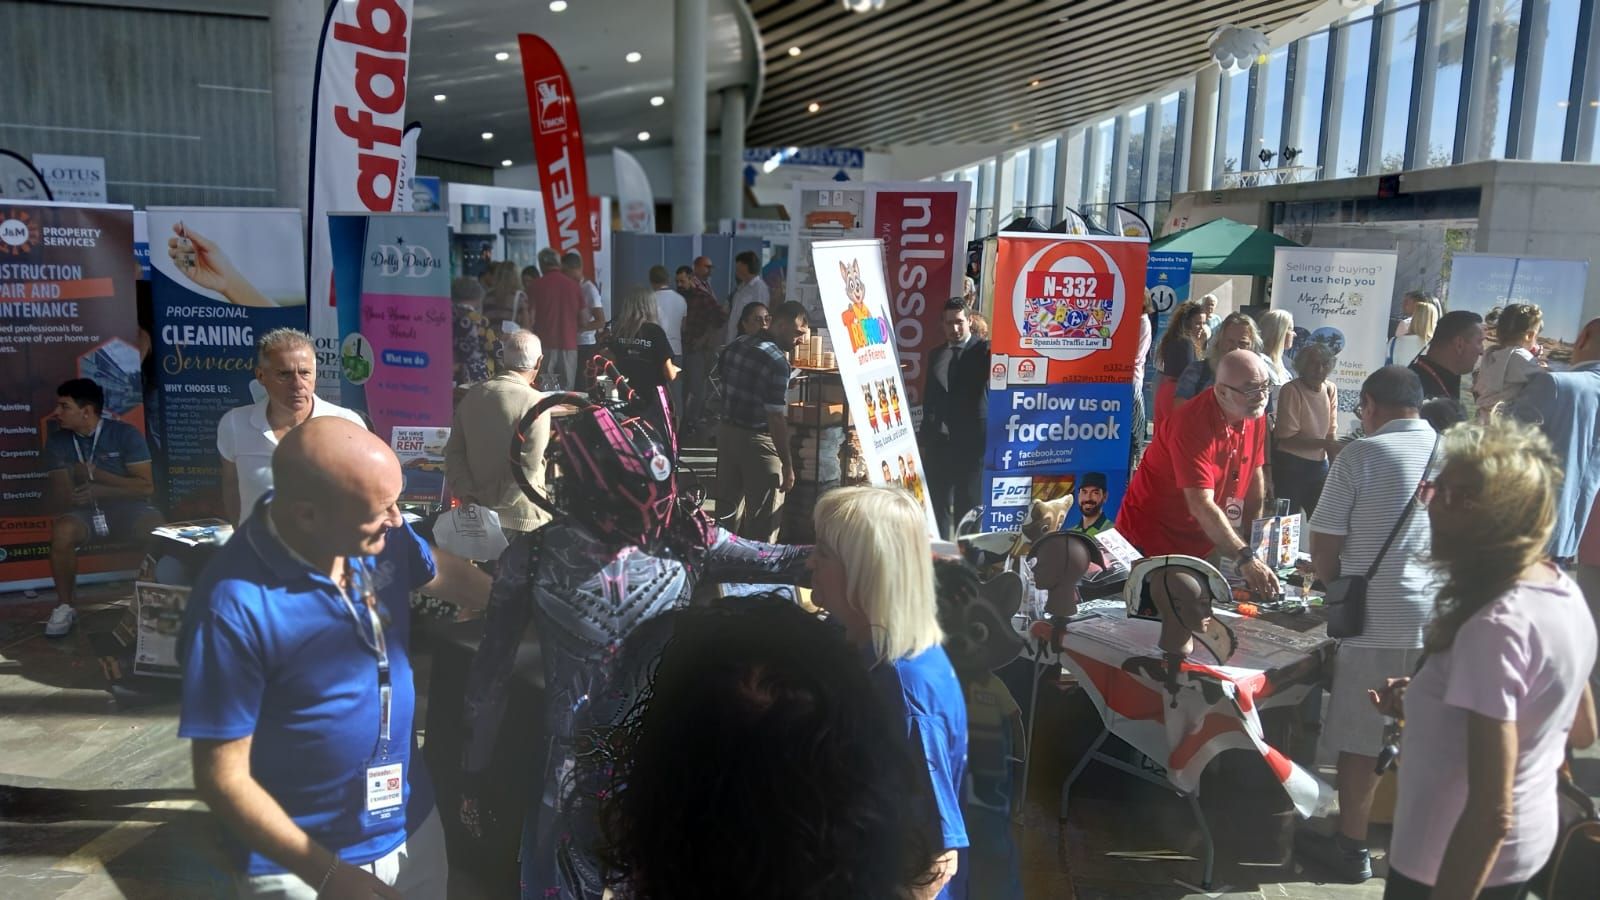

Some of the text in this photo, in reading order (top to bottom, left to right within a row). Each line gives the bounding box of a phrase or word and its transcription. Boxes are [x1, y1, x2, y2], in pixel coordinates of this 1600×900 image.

[43, 226, 101, 238] PROPERTY
[43, 236, 96, 247] SERVICES
[1286, 262, 1383, 276] Selling or buying?
[1290, 274, 1376, 287] Let us help you
[31, 283, 60, 298] AND
[1043, 276, 1098, 298] N-332
[896, 197, 946, 406] nilsson
[166, 306, 249, 318] PROFESIONAL
[1310, 302, 1358, 318] Properties
[14, 324, 70, 335] professionals
[71, 324, 83, 333] for
[161, 324, 254, 346] CLEANING
[33, 333, 42, 343] of
[44, 336, 63, 345] your
[64, 334, 88, 343] home
[1033, 339, 1099, 347] Spanish Traffic Law
[162, 342, 255, 376] Services
[385, 353, 425, 365] What we do
[1339, 361, 1363, 369] Make
[1335, 377, 1361, 385] move
[164, 384, 231, 393] WHY CHOOSE US:
[1012, 392, 1121, 412] Follow us on
[1005, 415, 1121, 443] facebook
[396, 441, 424, 451] RENT
[1, 449, 40, 460] Carpentry
[1018, 447, 1074, 460] facebook.com/
[3, 490, 42, 501] Electricity
[1006, 485, 1032, 496] DGT
[990, 510, 1027, 523] The S
[0, 519, 46, 530] Contact
